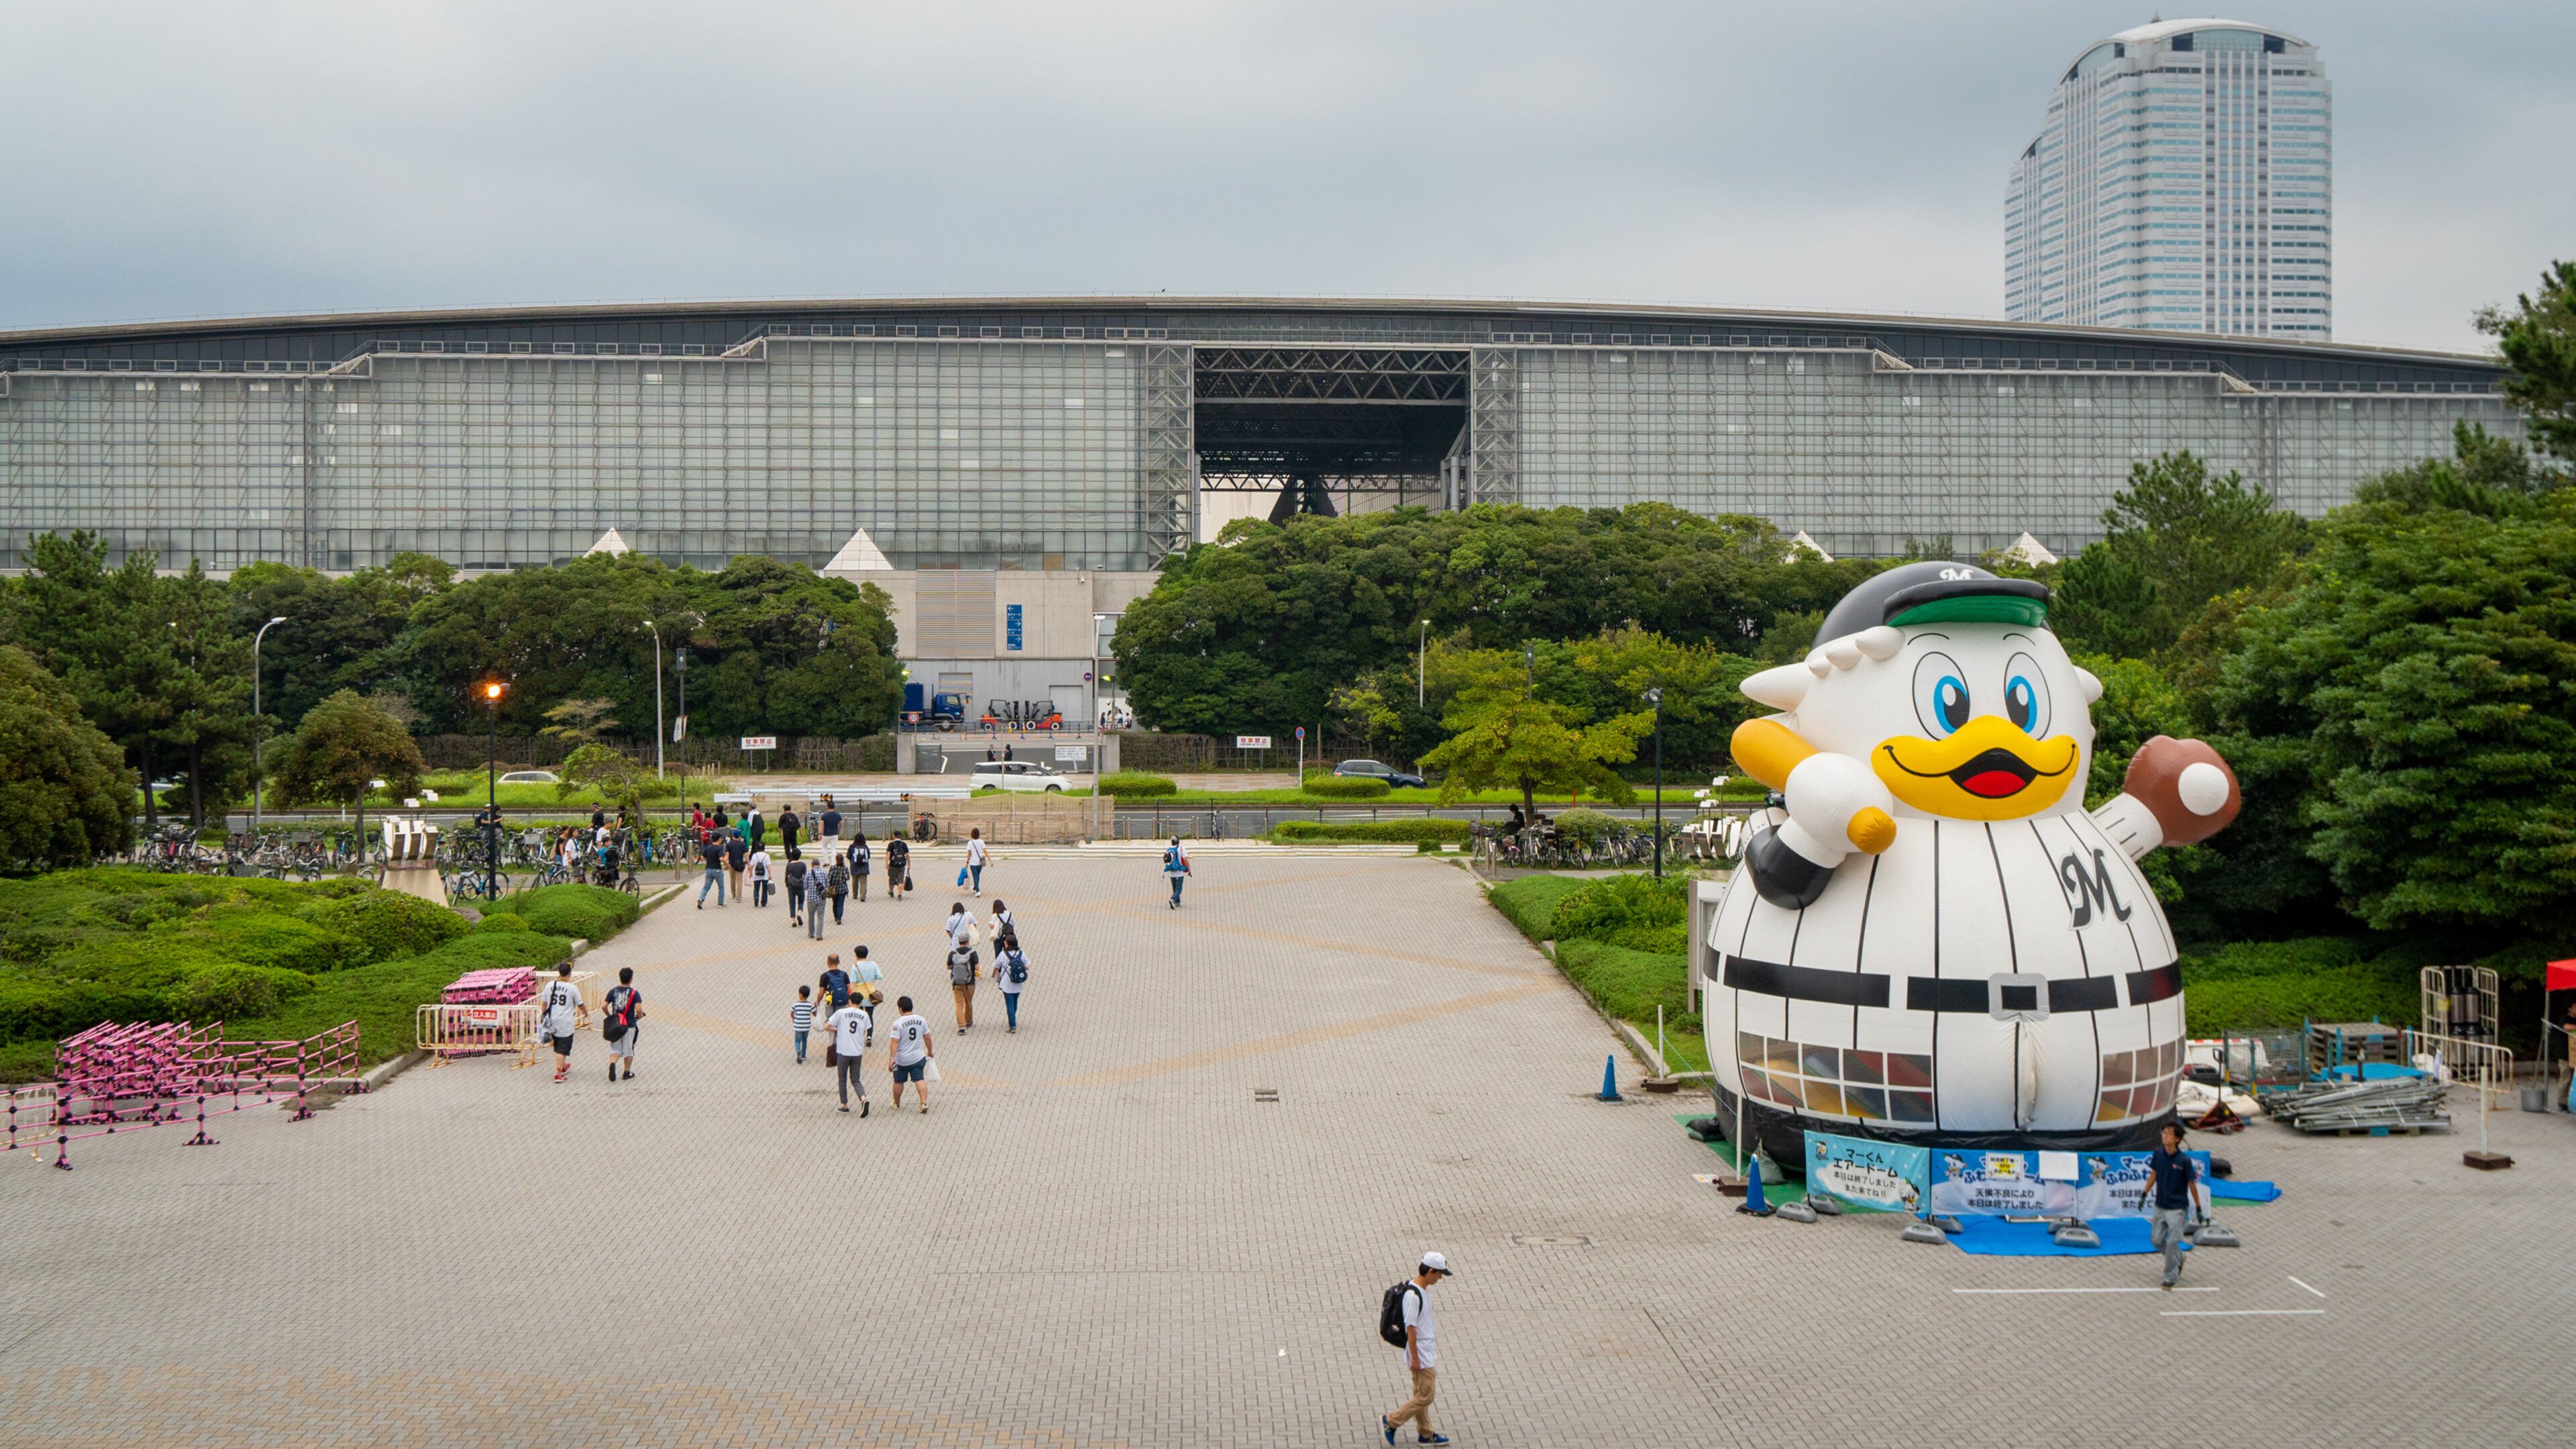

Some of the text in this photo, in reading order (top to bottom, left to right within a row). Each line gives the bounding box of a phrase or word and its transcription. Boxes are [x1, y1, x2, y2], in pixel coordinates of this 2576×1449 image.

[2060, 847, 2132, 928] M
[551, 994, 567, 1006] 69
[849, 1020, 857, 1034] 9
[908, 1028, 916, 1040] 9
[1845, 1148, 1884, 1164] マーくん
[1833, 1157, 1898, 1177] エアードーム
[1833, 1171, 1897, 1189] 本日は終了しました
[1975, 1187, 2035, 1198] 天候不良により
[1968, 1199, 2044, 1210] 本日は終了しました
